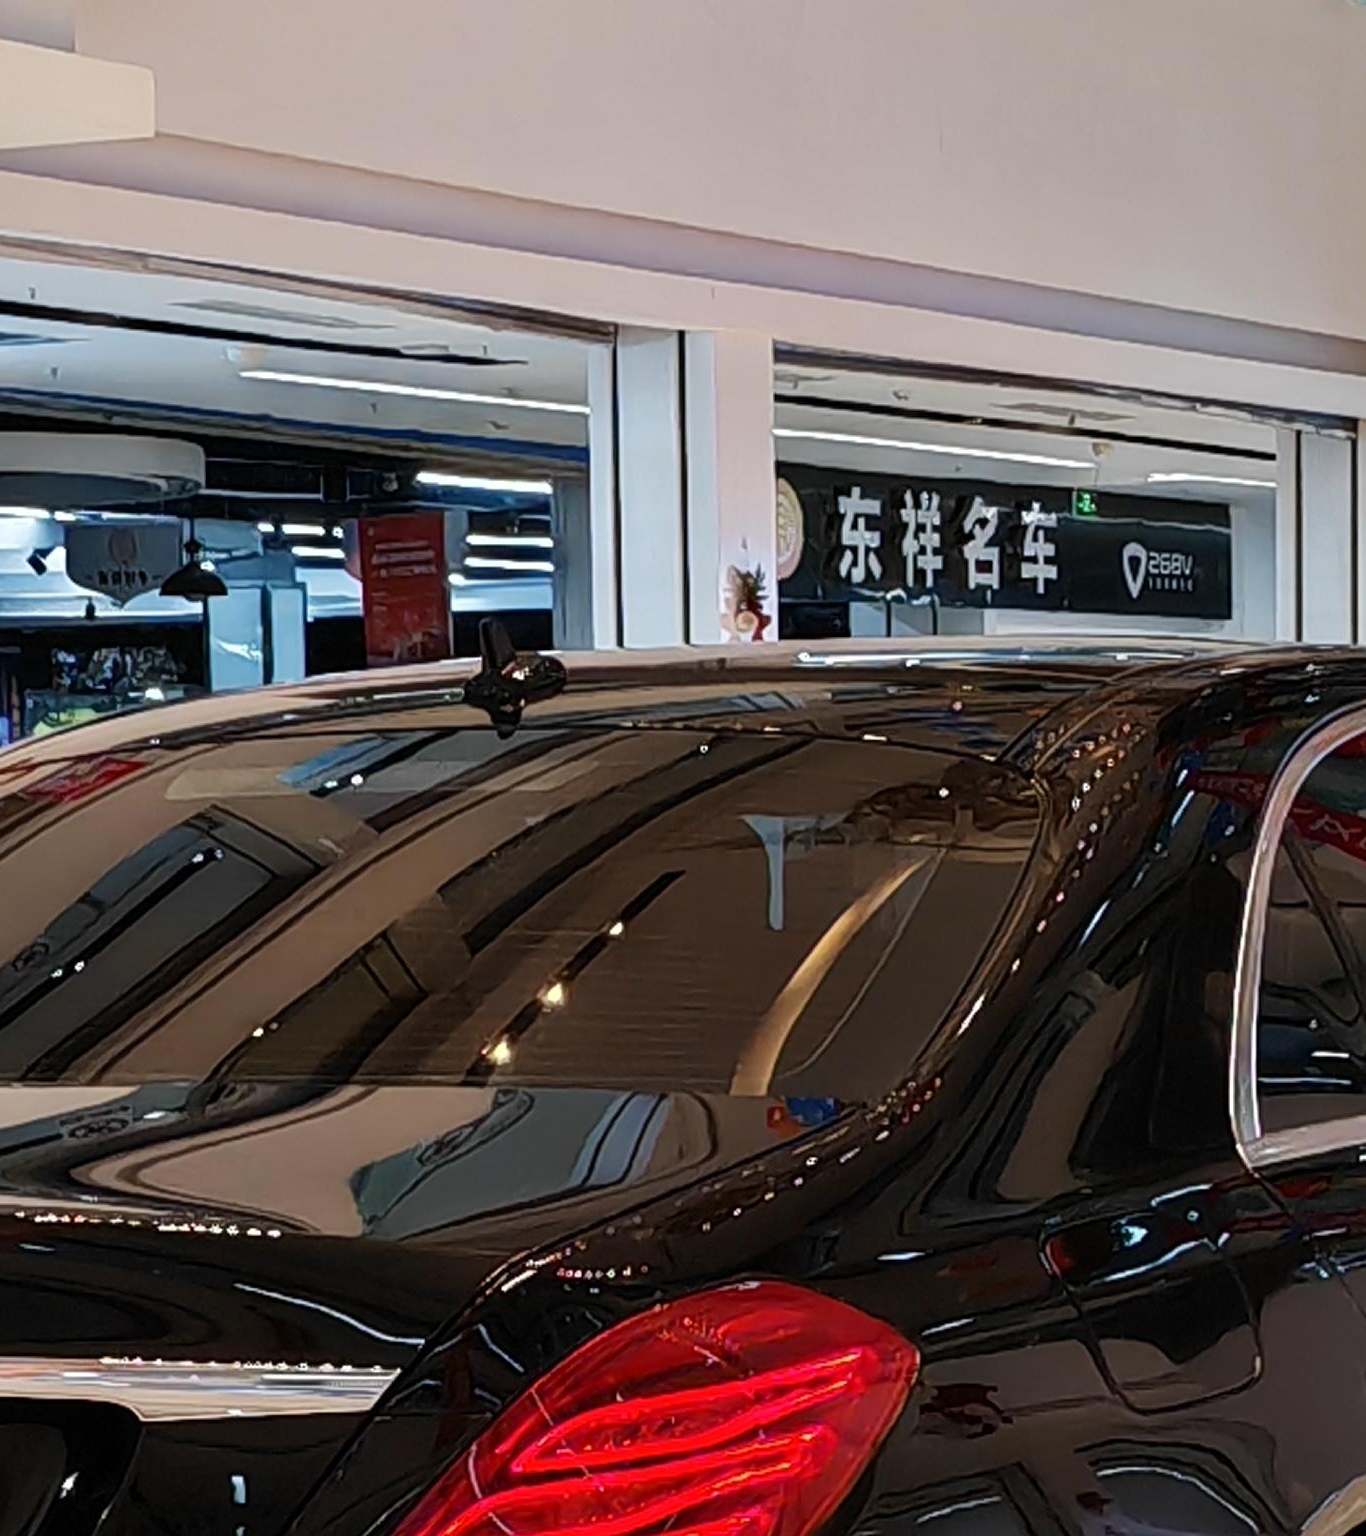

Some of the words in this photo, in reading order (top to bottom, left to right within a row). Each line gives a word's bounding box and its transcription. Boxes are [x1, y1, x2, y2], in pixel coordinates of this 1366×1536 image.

[837, 486, 1059, 596] 东祥名车
[1148, 551, 1194, 576] 268V
